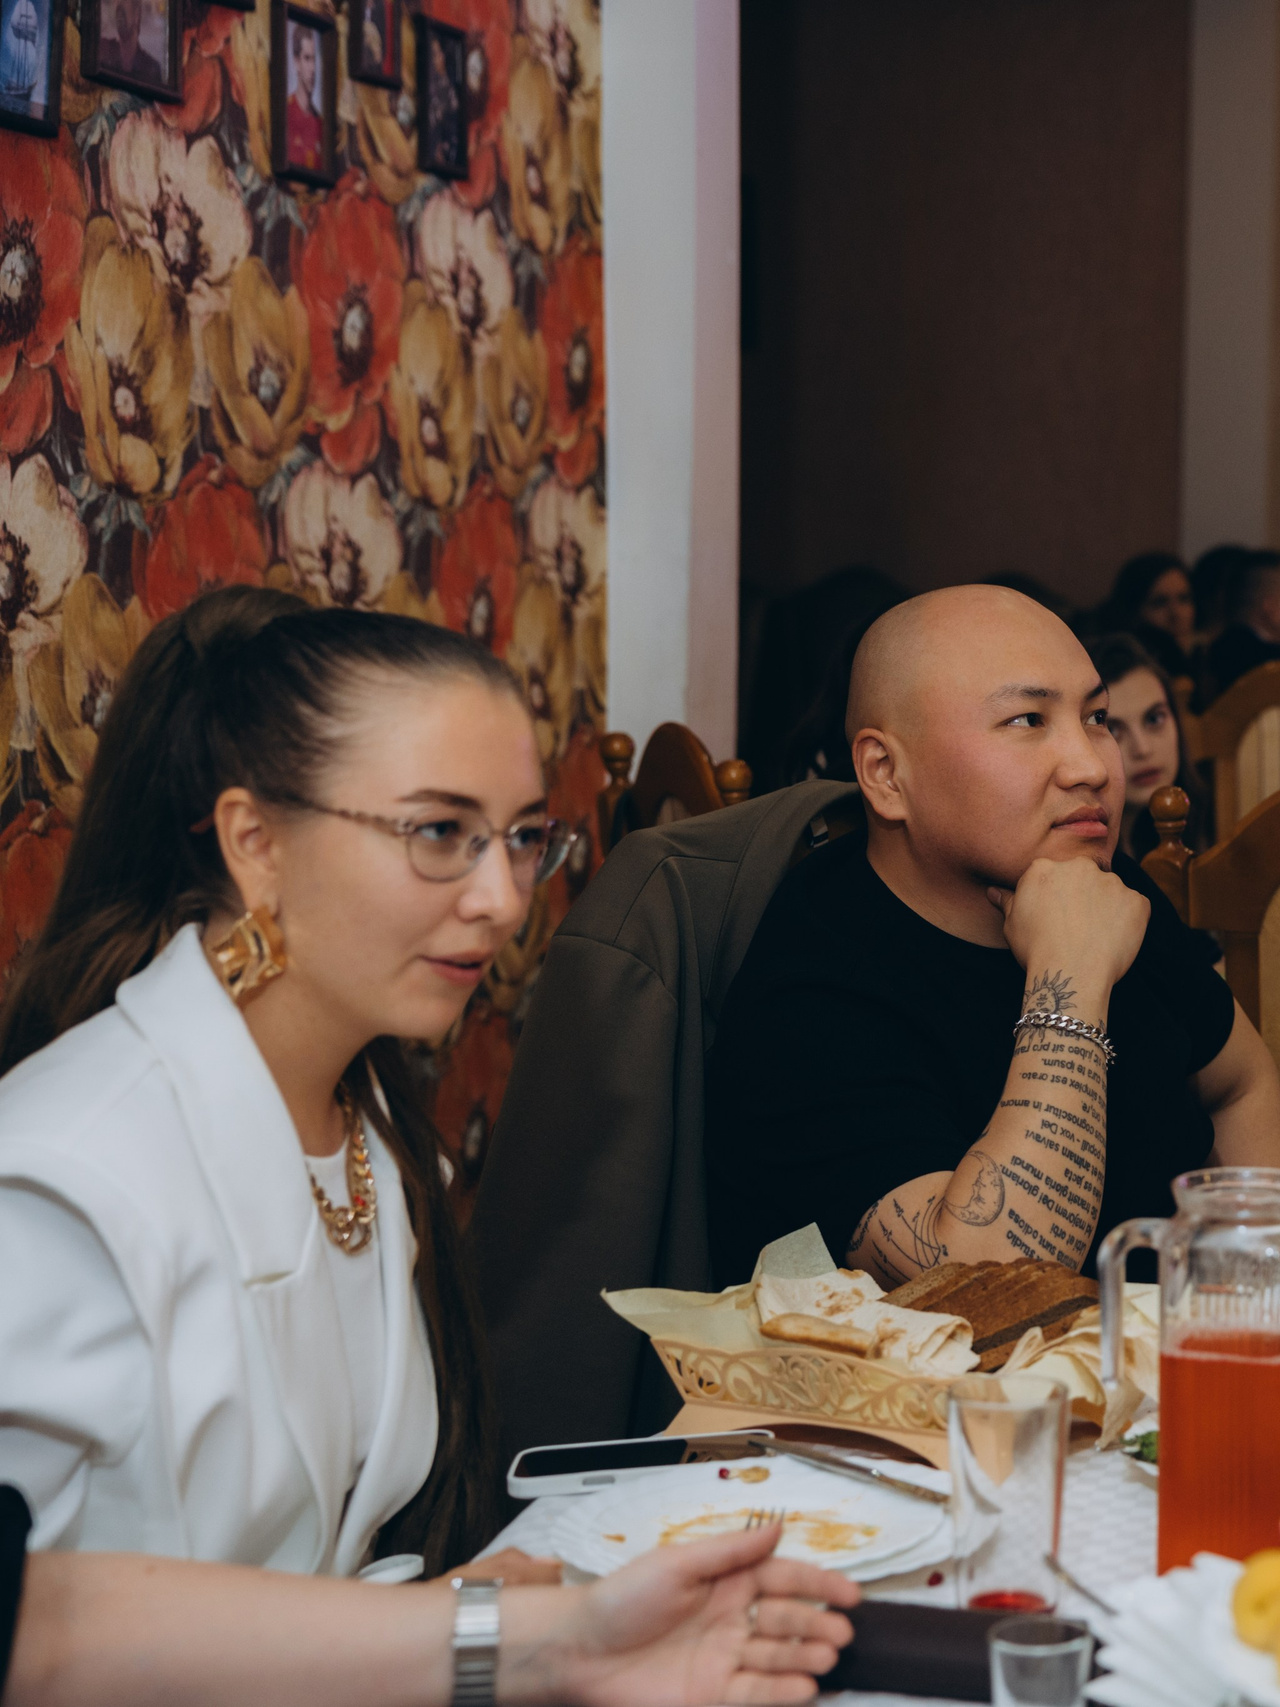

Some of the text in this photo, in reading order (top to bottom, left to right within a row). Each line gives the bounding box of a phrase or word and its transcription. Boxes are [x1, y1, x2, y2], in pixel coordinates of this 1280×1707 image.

[1032, 1042, 1051, 1053] pro
[1050, 1044, 1066, 1054] sit
[1067, 1046, 1094, 1062] jubeo
[1041, 1058, 1076, 1074] ipsum.
[1077, 1064, 1086, 1076] te
[1050, 1074, 1068, 1086] est
[1069, 1078, 1099, 1103] simplex
[1032, 1101, 1043, 1112] in
[1040, 1119, 1059, 1135] Dei
[1043, 1103, 1095, 1136] cognoscitur
[1059, 1127, 1075, 1143] vox
[1010, 1155, 1044, 1181] mundi
[1061, 1146, 1091, 1172] animam
[999, 1163, 1040, 1198] gloriam.
[1044, 1175, 1069, 1198] gloria
[1064, 1167, 1085, 1189] jacta
[1037, 1192, 1056, 1212] Dei
[1067, 1191, 1091, 1215] transit
[1007, 1208, 1039, 1240] odiosa
[1054, 1203, 1086, 1232] majorem
[1049, 1222, 1067, 1241] orbi
[1066, 1234, 1075, 1246] et
[1005, 1230, 1036, 1260] studio
[1037, 1235, 1057, 1256] sunt
